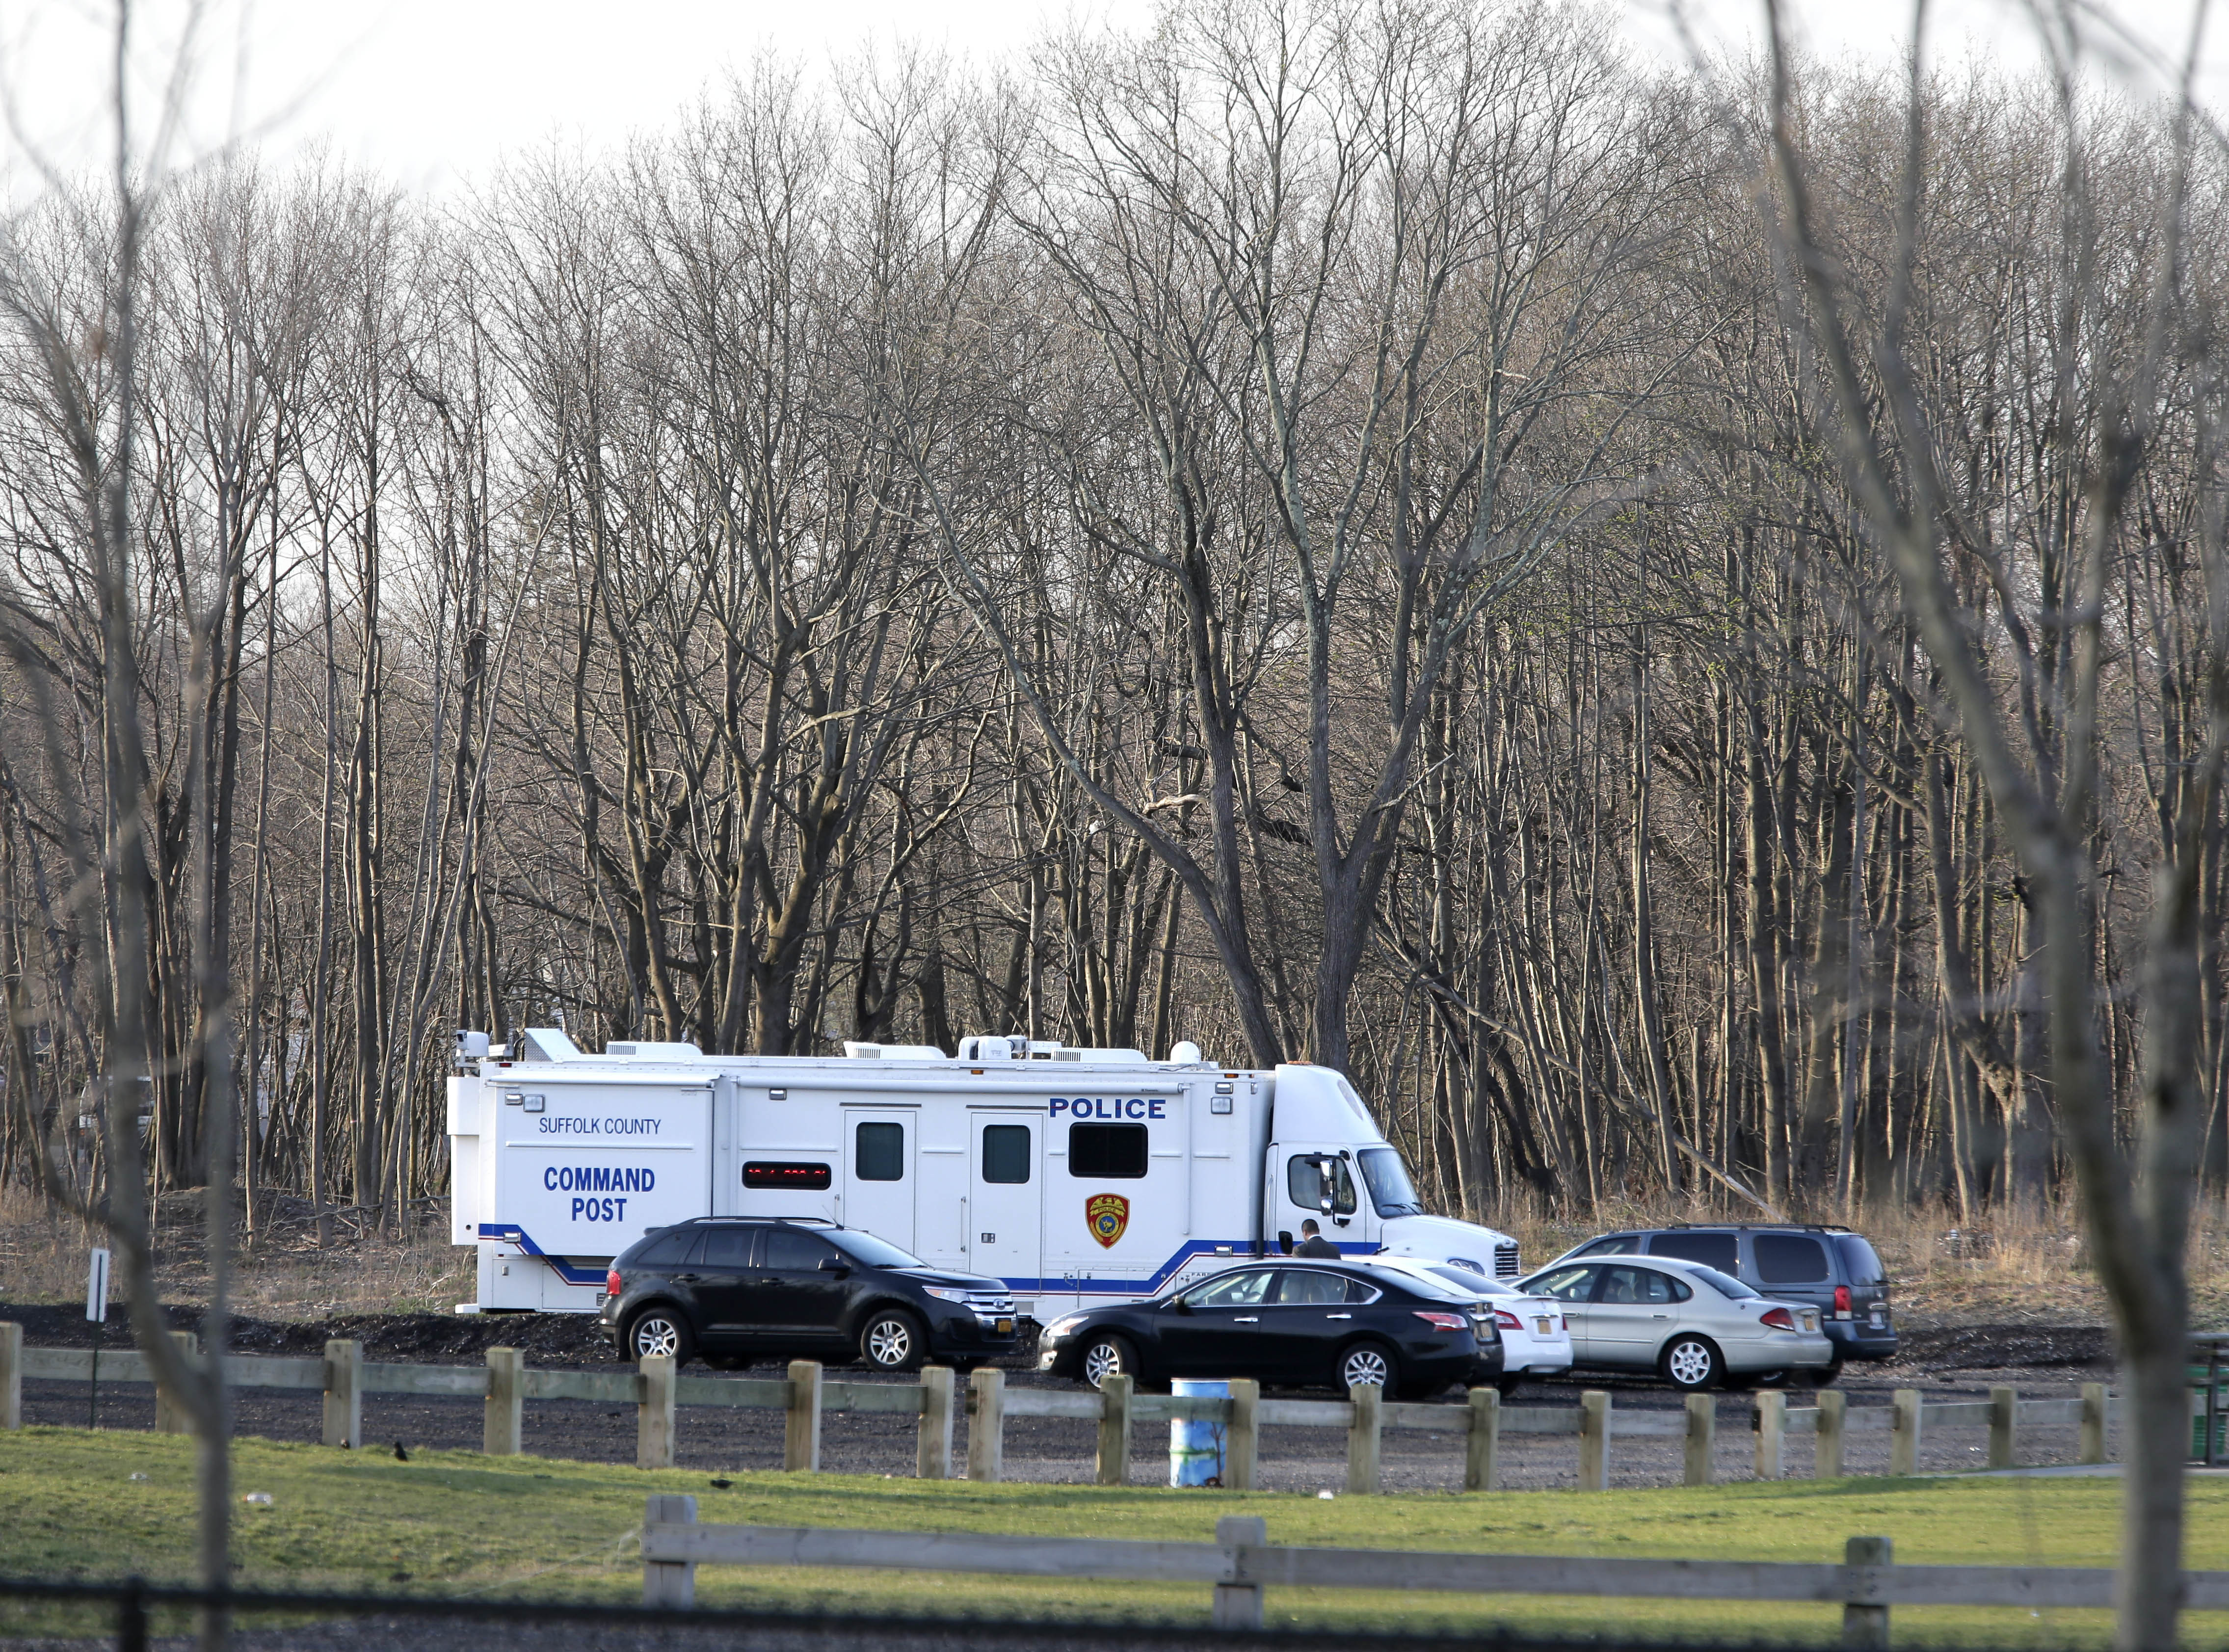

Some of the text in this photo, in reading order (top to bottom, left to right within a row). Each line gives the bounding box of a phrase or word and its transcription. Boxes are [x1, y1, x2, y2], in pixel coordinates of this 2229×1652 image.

[1049, 1097, 1166, 1119] POLICE
[539, 1117, 662, 1135] SUFFOLK COUNTY
[544, 1167, 655, 1193] COMMAND
[572, 1198, 627, 1222] POST
